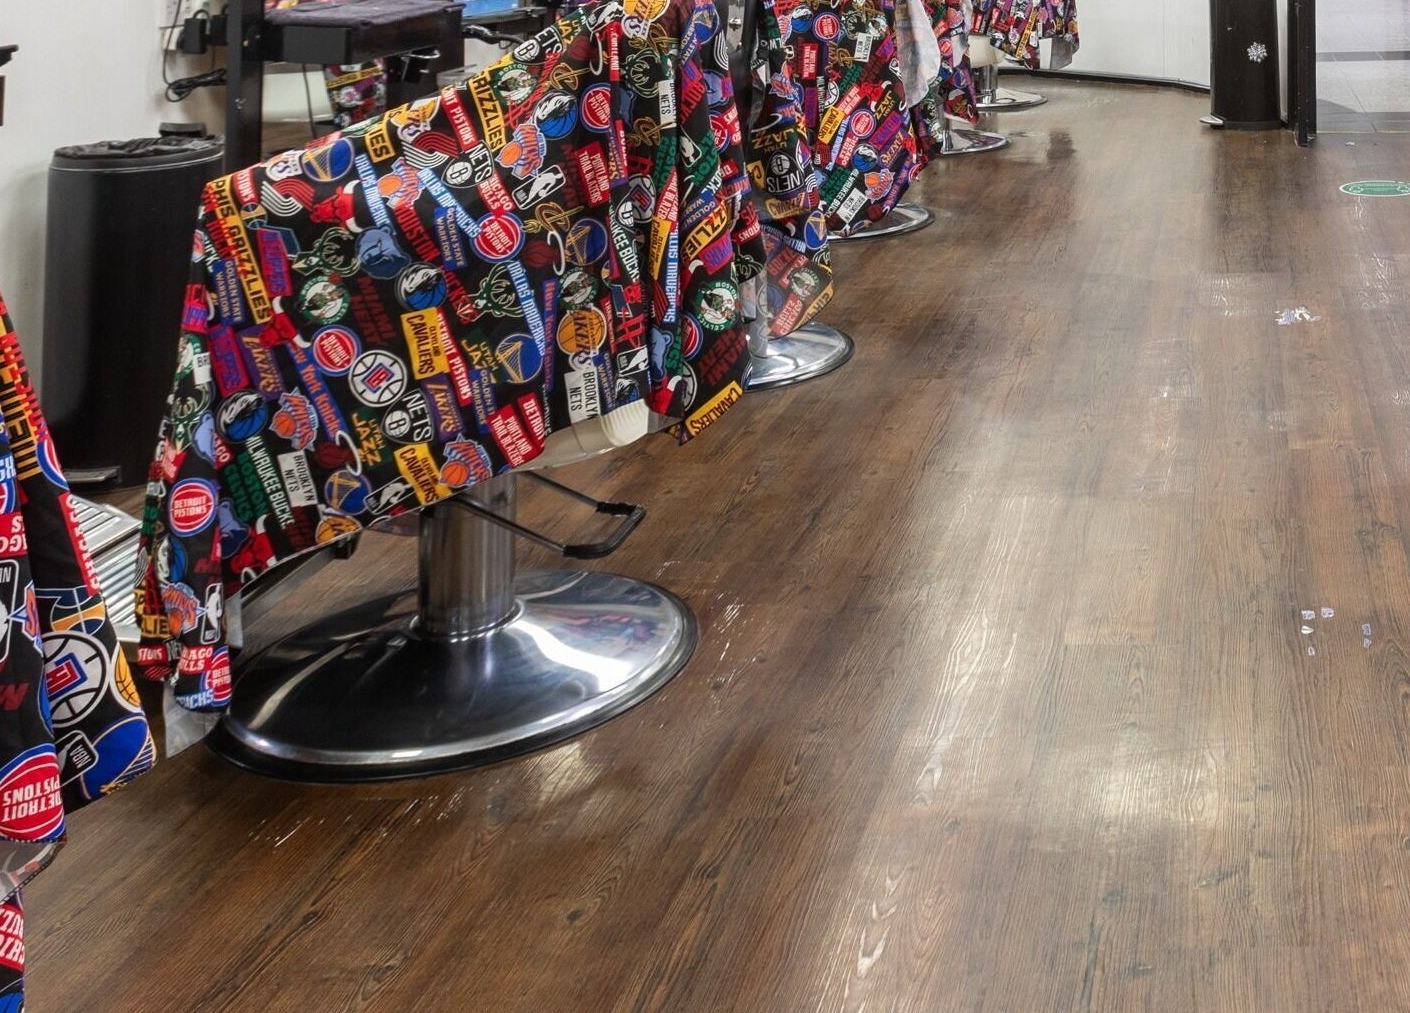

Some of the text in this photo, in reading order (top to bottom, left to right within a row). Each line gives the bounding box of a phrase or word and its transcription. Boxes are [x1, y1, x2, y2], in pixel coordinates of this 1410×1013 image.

[660, 93, 671, 115] NETS
[874, 91, 892, 119] JAZZ
[451, 107, 475, 145] PISTONS
[468, 143, 492, 182] NETS
[479, 182, 500, 210] BULLS
[766, 172, 801, 194] NETS
[483, 226, 506, 253] PISTONS
[491, 220, 513, 247] DETROIT
[229, 224, 270, 320] GRIZZLIES
[225, 261, 242, 322] GOLDEN STATE
[715, 281, 738, 299] BOSTON
[507, 261, 546, 357] DALLAS MAVERICKS
[329, 333, 351, 362] DETROIT
[406, 313, 434, 375] CAVALIERS
[449, 357, 472, 400] PISTONS
[582, 370, 599, 419] BROOKLYN
[569, 386, 582, 412] NETS
[690, 385, 742, 435] CAVALIERS
[402, 393, 433, 442] NETS
[490, 416, 507, 440] TRAIL
[351, 412, 382, 466] JAZZ
[505, 415, 532, 455] PORTLAND
[284, 469, 300, 493] NETS
[293, 454, 317, 501] BROOKLYN
[400, 447, 440, 502] CAVALIERS
[174, 495, 207, 509] DETROIT
[174, 504, 207, 518] PISTONS
[70, 744, 91, 768] NBA
